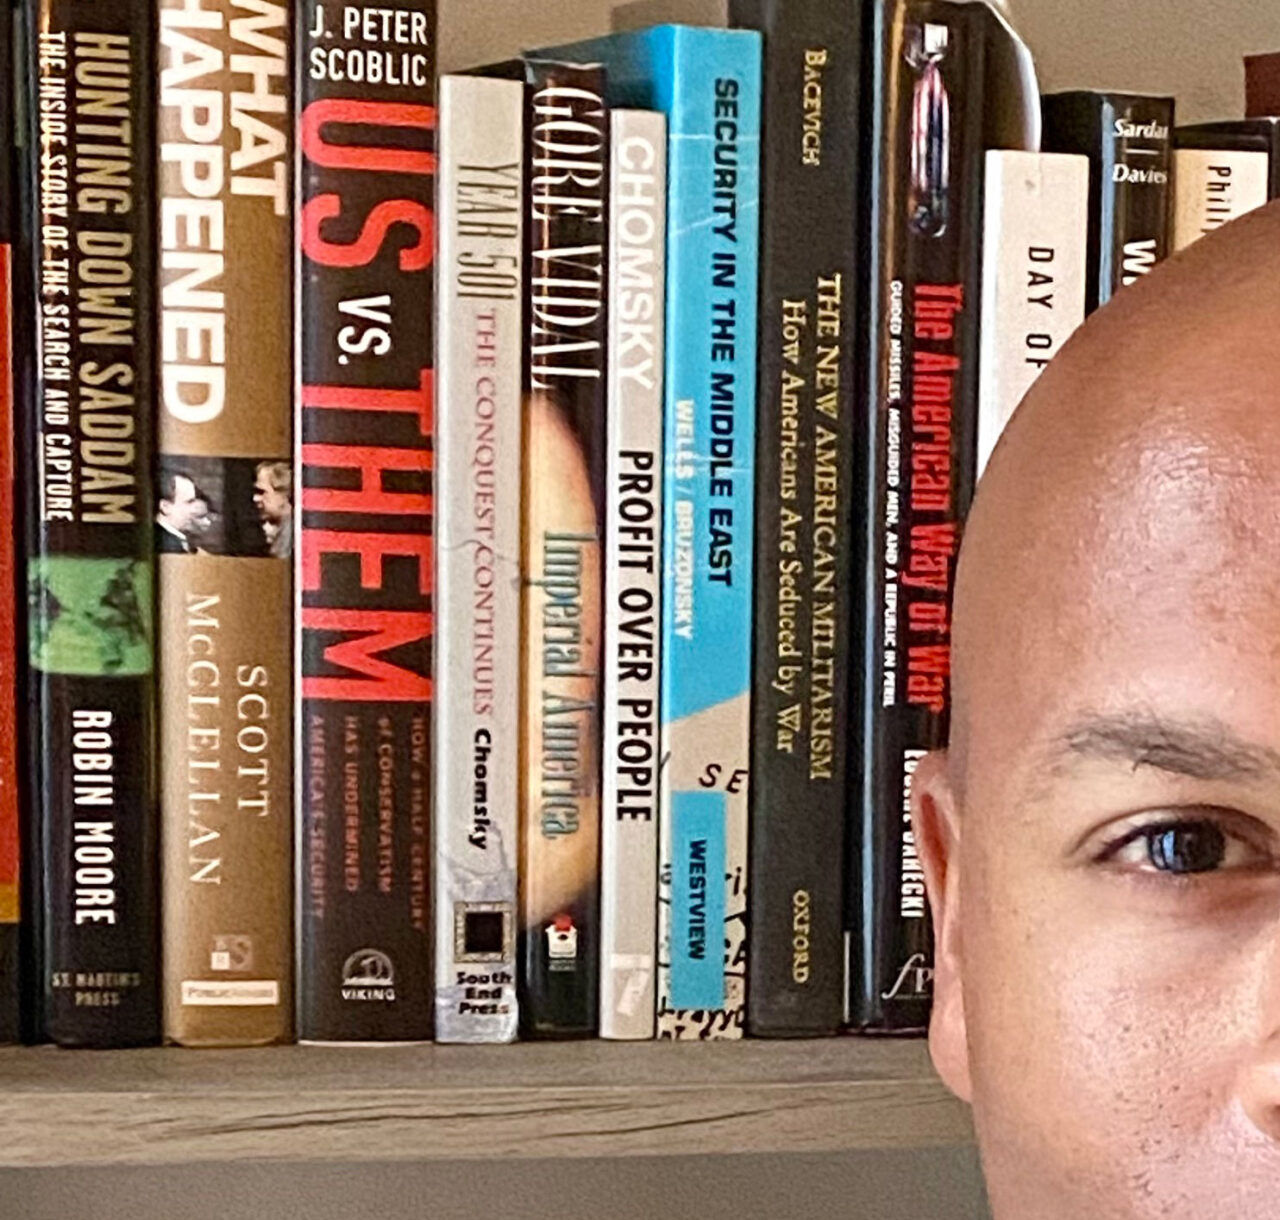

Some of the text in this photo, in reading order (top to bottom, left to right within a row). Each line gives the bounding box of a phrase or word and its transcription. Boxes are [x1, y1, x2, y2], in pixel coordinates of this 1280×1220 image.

[309, 6, 427, 46] J. PETER
[309, 48, 427, 86] SCOBLIC
[229, 0, 287, 216] WHAT
[801, 48, 828, 167] BACEVICH
[301, 99, 436, 272] US
[457, 162, 520, 301] YEAR 501
[1111, 162, 1169, 184] Davies
[39, 31, 73, 523] THE INSIDE STORY OF THE SEARCH AND CAPTURE
[74, 32, 136, 524] HUNTING DOWN SADDAM
[532, 87, 603, 391] GORE VIDAL
[616, 135, 656, 392] CHOMSKY
[337, 295, 392, 366] VS.
[708, 77, 739, 587] SECURITY IN THE MIDDLE EAST
[888, 280, 904, 335] GUIDED
[913, 283, 963, 340] The
[1024, 246, 1055, 370] DAY OF
[675, 399, 695, 480] WELLS
[910, 350, 959, 511] American
[300, 367, 434, 701] THEM
[467, 307, 497, 851] THE CONQUEST CONTINUES Chomsky
[771, 299, 807, 755] How Americans Are Seduced by War
[809, 273, 842, 781] THE NEW AMERICAN MILITARISM
[884, 531, 899, 566] AND
[884, 567, 898, 580] A
[901, 522, 957, 592] Way
[616, 450, 655, 823] PROFIT OVER PEOPLE
[883, 649, 897, 669] IN
[908, 602, 949, 633] of
[523, 529, 599, 841] Imperial America
[907, 645, 951, 714] War
[236, 664, 270, 818] SCOTT
[72, 708, 117, 926] ROBIN MOORE
[344, 715, 360, 892] HAS UNDERMINED
[309, 828, 326, 919] SECURITY
[688, 839, 708, 961] WESTVIEW
[341, 987, 396, 1002] VIKING
[457, 973, 513, 986] South
[465, 986, 503, 1000] End
[792, 889, 811, 984] OXFORD
[459, 1001, 510, 1015] Press
